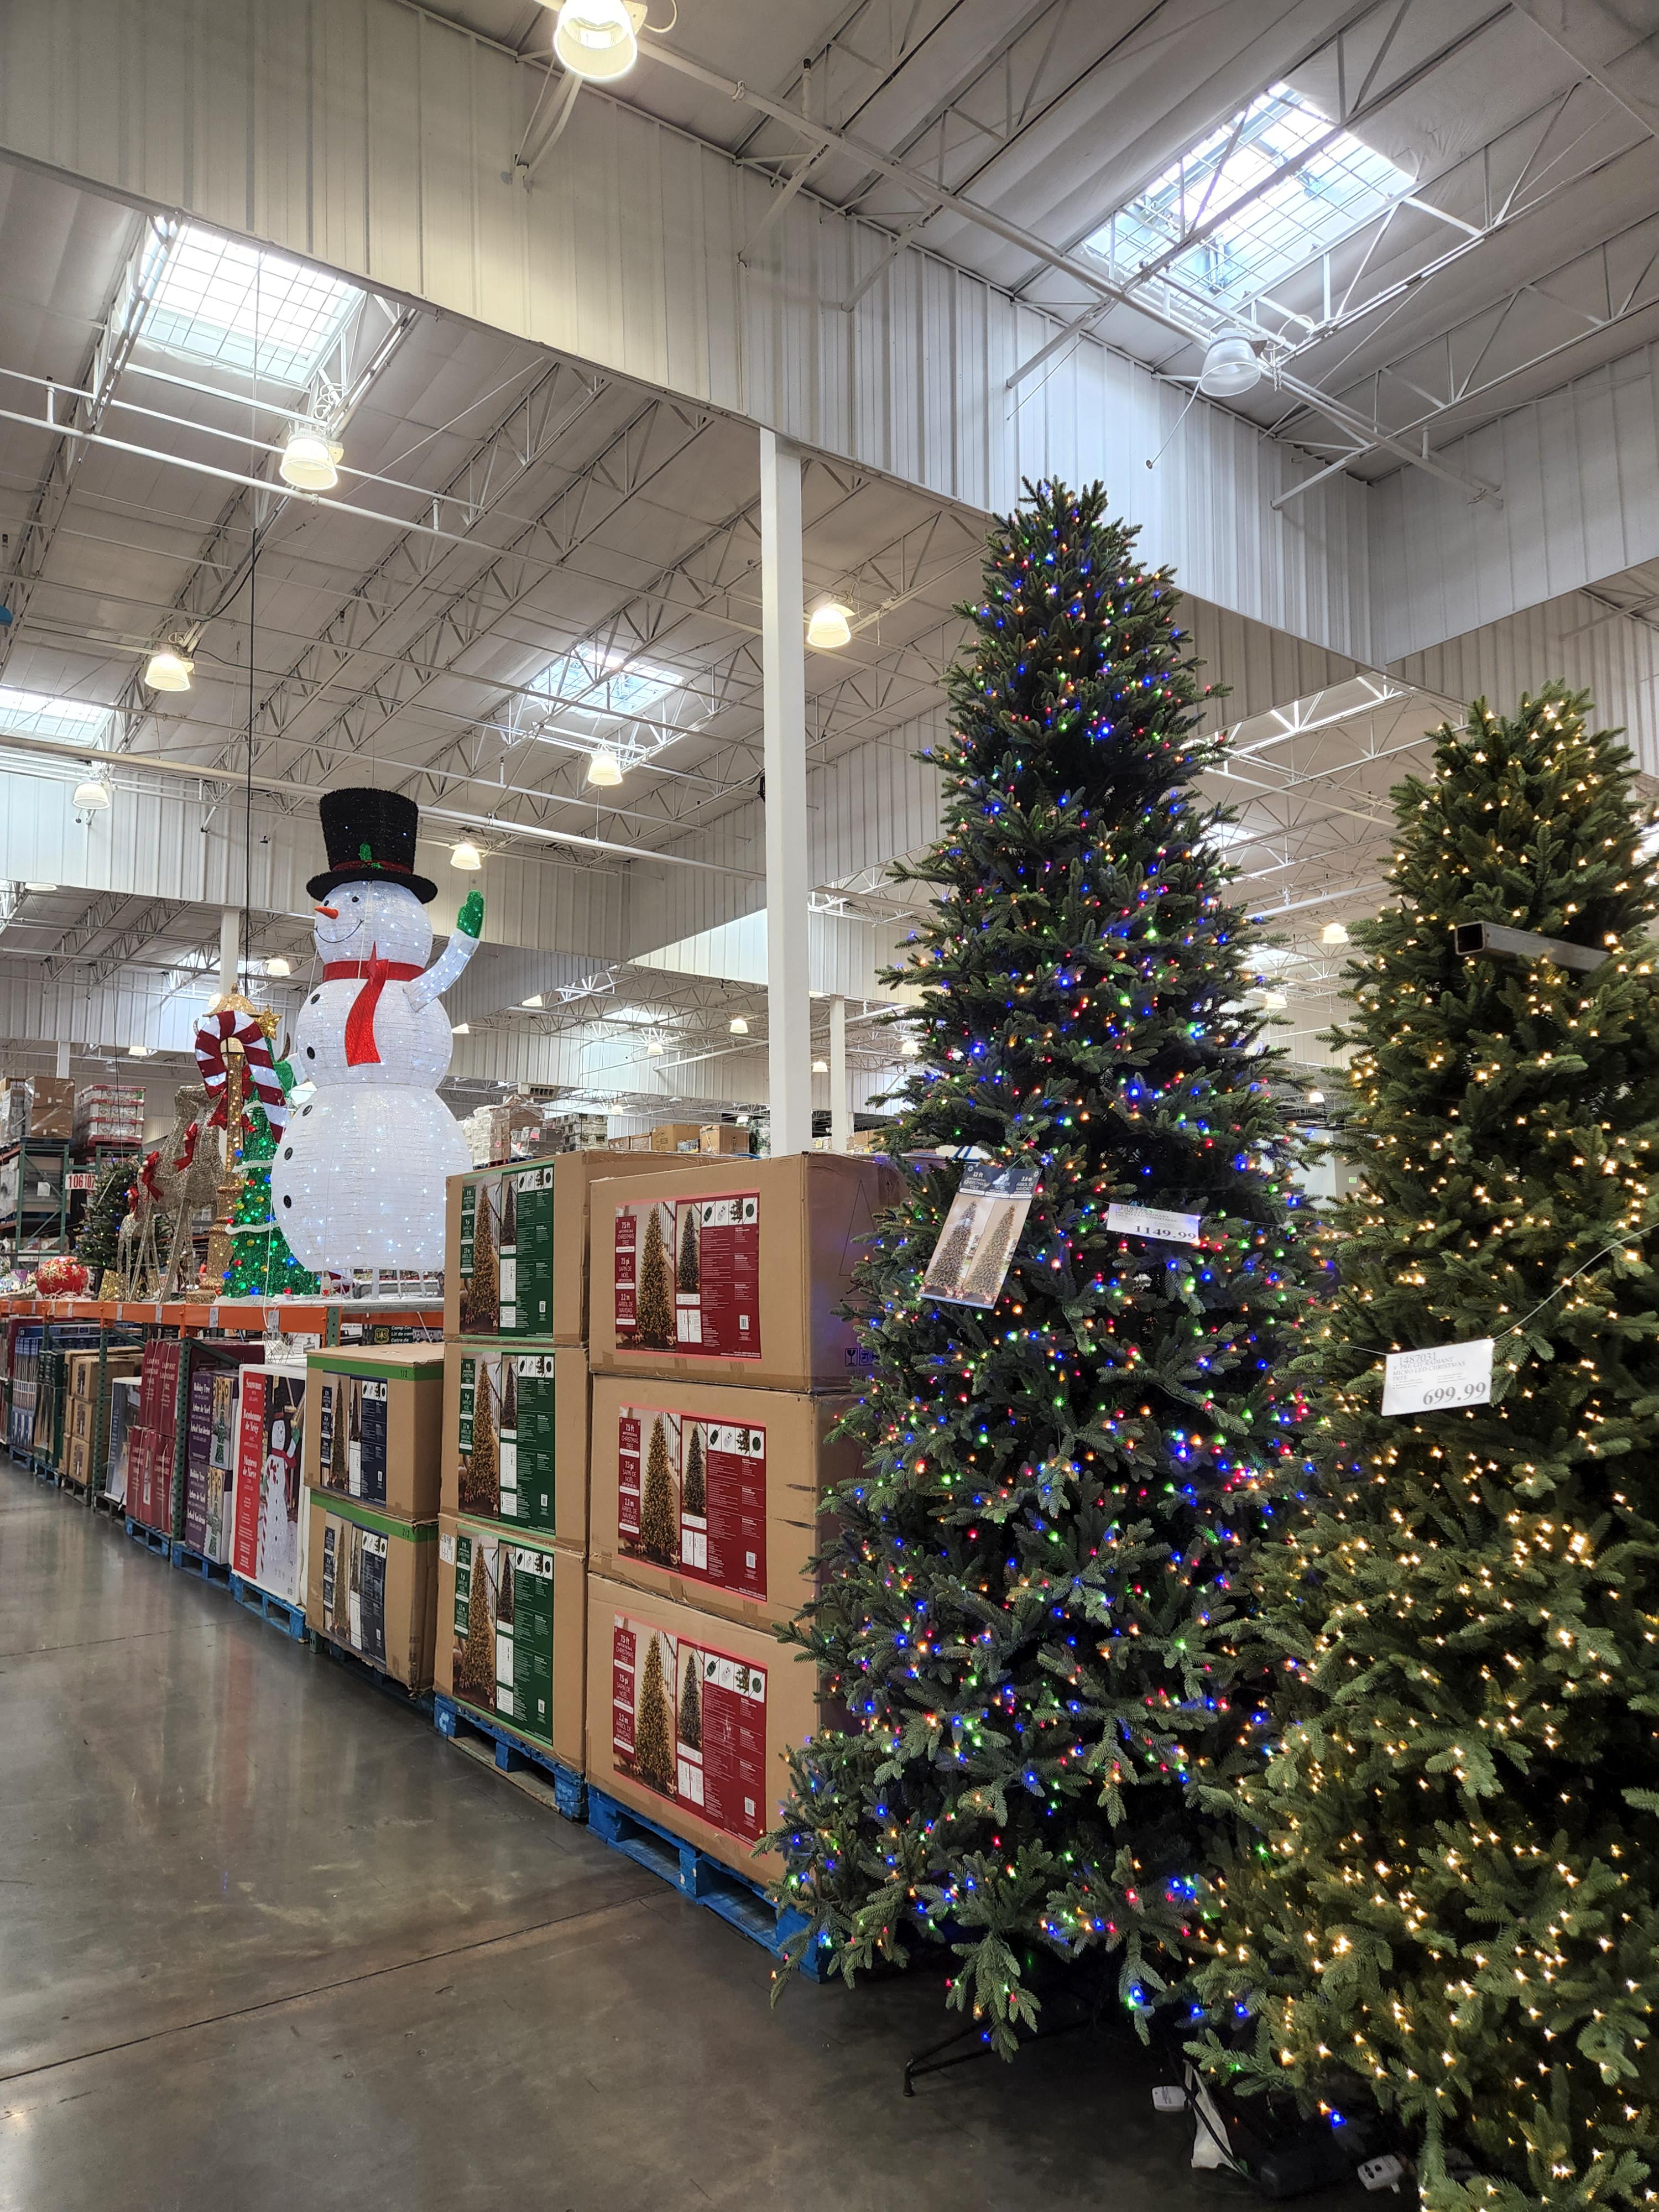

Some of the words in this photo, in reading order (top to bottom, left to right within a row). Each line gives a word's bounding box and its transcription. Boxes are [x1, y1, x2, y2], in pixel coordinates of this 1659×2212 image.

[69, 1175, 83, 1188] 106
[85, 1175, 96, 1188] 107
[1135, 1225, 1196, 1239] 1149.99
[1399, 1353, 1436, 1366] 1487031
[1425, 1357, 1454, 1366] RADIANT
[1428, 1361, 1466, 1371] CHRISTMAS
[1423, 1382, 1486, 1405] 699.99
[621, 1436, 639, 1444] CHRISTMAS
[622, 1512, 637, 1521] NAVIDAD
[625, 1637, 630, 1645] ft
[615, 1646, 633, 1658] CHRISTMAS
